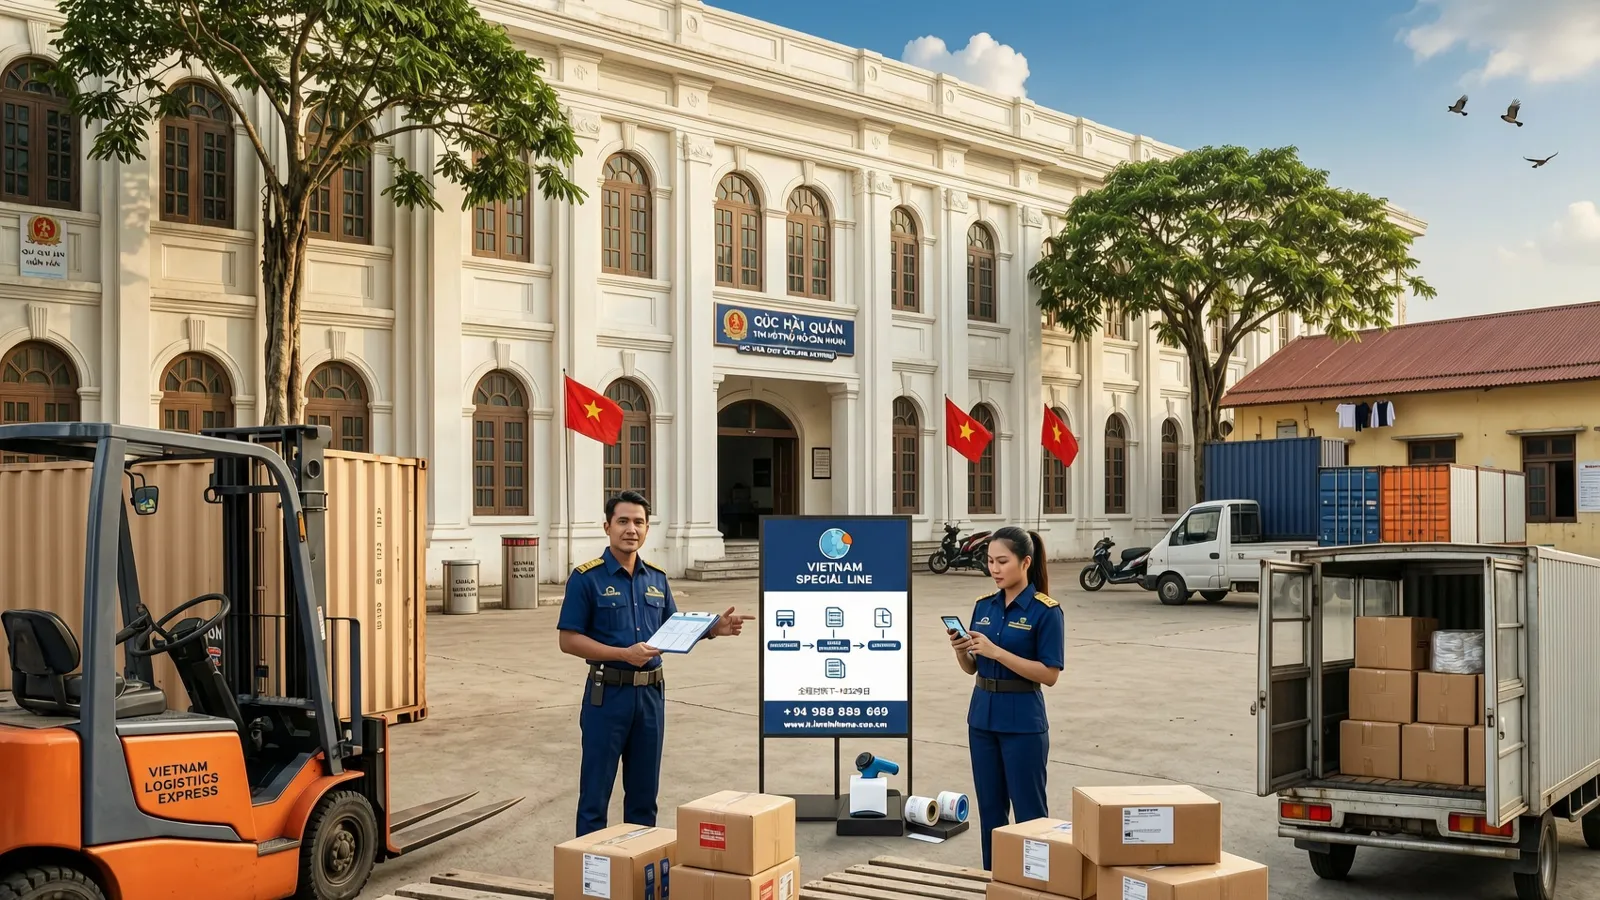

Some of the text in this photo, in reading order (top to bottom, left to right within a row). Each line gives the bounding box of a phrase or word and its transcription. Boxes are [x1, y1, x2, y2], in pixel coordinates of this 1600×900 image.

[807, 562, 863, 572] VIETNAM
[796, 574, 873, 584] SPECIAL LINE
[148, 761, 208, 778] VIETNAM
[158, 785, 218, 804] EXPRESS
